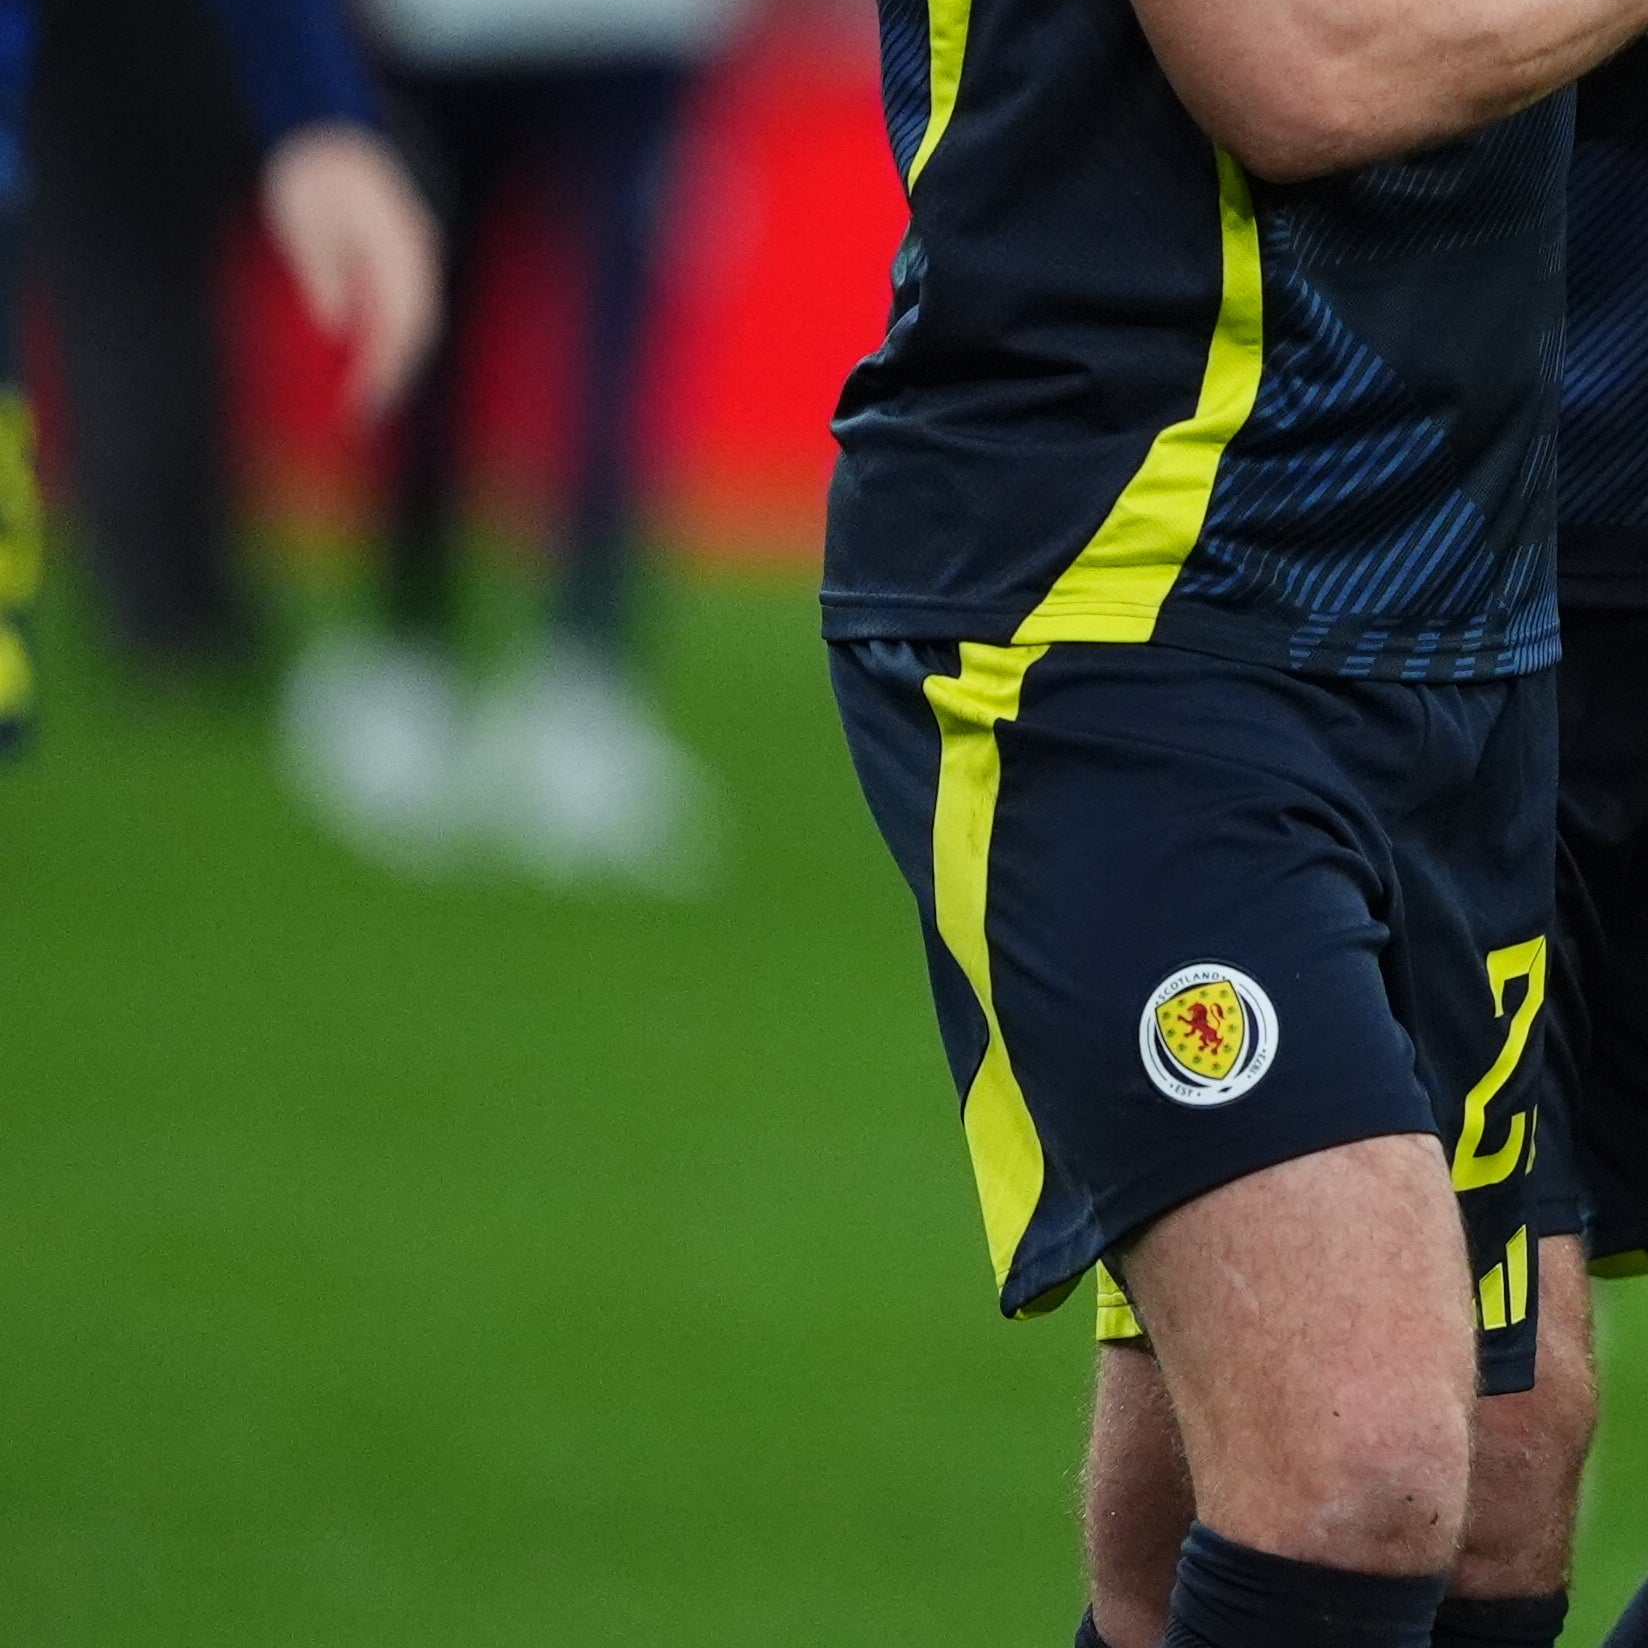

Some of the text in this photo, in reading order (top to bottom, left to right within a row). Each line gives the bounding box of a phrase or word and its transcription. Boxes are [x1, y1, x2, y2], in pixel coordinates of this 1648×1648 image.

[1158, 971, 1220, 1001] SCOTLAND
[1250, 1054, 1267, 1075] 1873
[1452, 934, 1546, 1192] 2
[1174, 1085, 1194, 1097] EST
